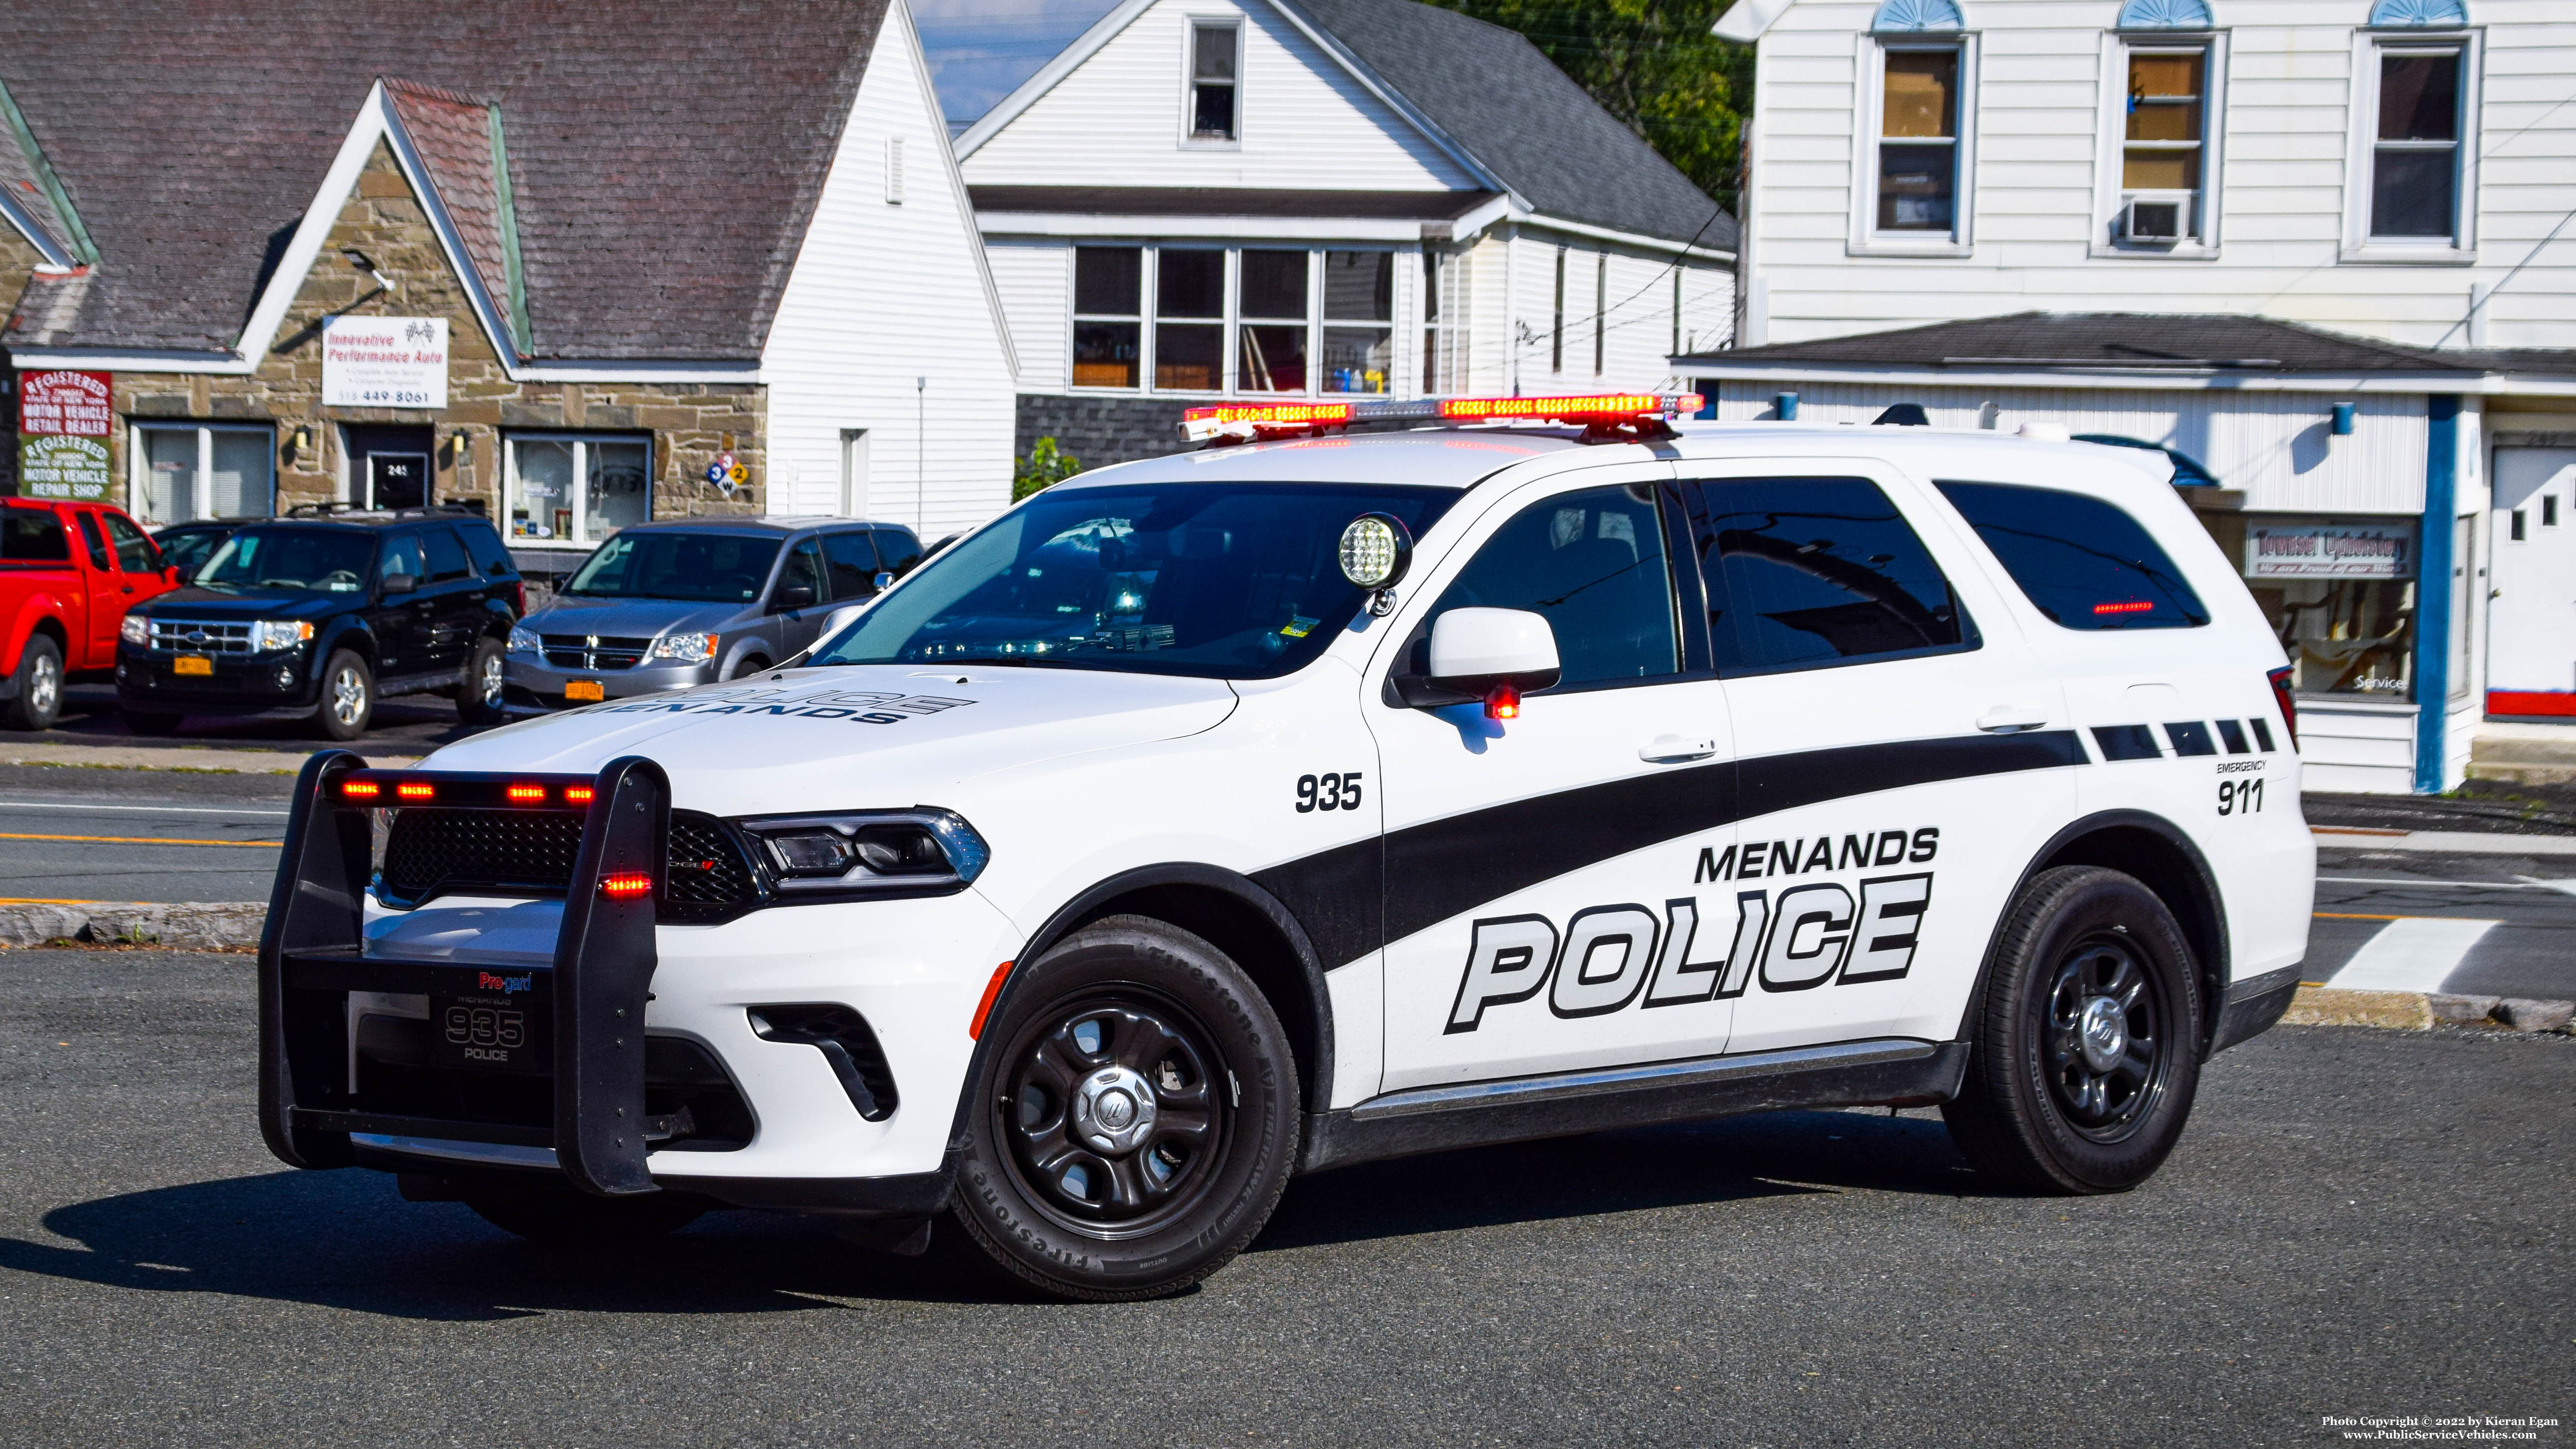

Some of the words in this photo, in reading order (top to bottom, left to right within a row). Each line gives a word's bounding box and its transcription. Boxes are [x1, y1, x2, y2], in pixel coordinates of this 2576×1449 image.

[328, 332, 394, 346] Innovative
[328, 349, 409, 363] Performance
[414, 350, 443, 363] Auto
[25, 371, 108, 397] REGISTERED
[25, 395, 49, 403] STATE
[64, 396, 83, 405] NEW
[24, 403, 62, 418] MOTOR
[64, 405, 109, 420] VEHICLE
[25, 418, 63, 433] RETAIL
[65, 420, 108, 434] DEALER
[25, 435, 108, 460] REGISTERED
[64, 460, 83, 469] NEW
[84, 461, 108, 469] YORK
[722, 455, 733, 469] 3
[24, 468, 61, 482] MOTOR
[62, 469, 109, 484] VEHICLE
[711, 466, 722, 479] 3
[735, 467, 742, 478] 2
[32, 482, 71, 496] REPAIR
[73, 483, 104, 498] SHOP
[2256, 529, 2318, 556] Townsel
[2324, 530, 2409, 561] Upholstery
[2259, 563, 2274, 573] We
[2299, 563, 2334, 573] Proud
[2335, 563, 2349, 574] of
[2372, 563, 2402, 573] Work
[2217, 760, 2266, 773] EMERGENCY
[1296, 772, 1362, 813] 935
[2218, 777, 2264, 816] 911
[1694, 826, 1939, 885] MENANDS
[1443, 871, 1934, 1036] POLICE
[479, 972, 531, 994] Pro-gard
[1147, 946, 1261, 1048] Firestone
[446, 1007, 524, 1048] 935
[465, 1048, 508, 1061] POLICE
[1241, 1100, 1276, 1202] FIREHAWK
[974, 1172, 1090, 1271] Firestone
[1222, 1201, 1245, 1228] PURSUIT
[1138, 1257, 1167, 1269] OUTSIDE
